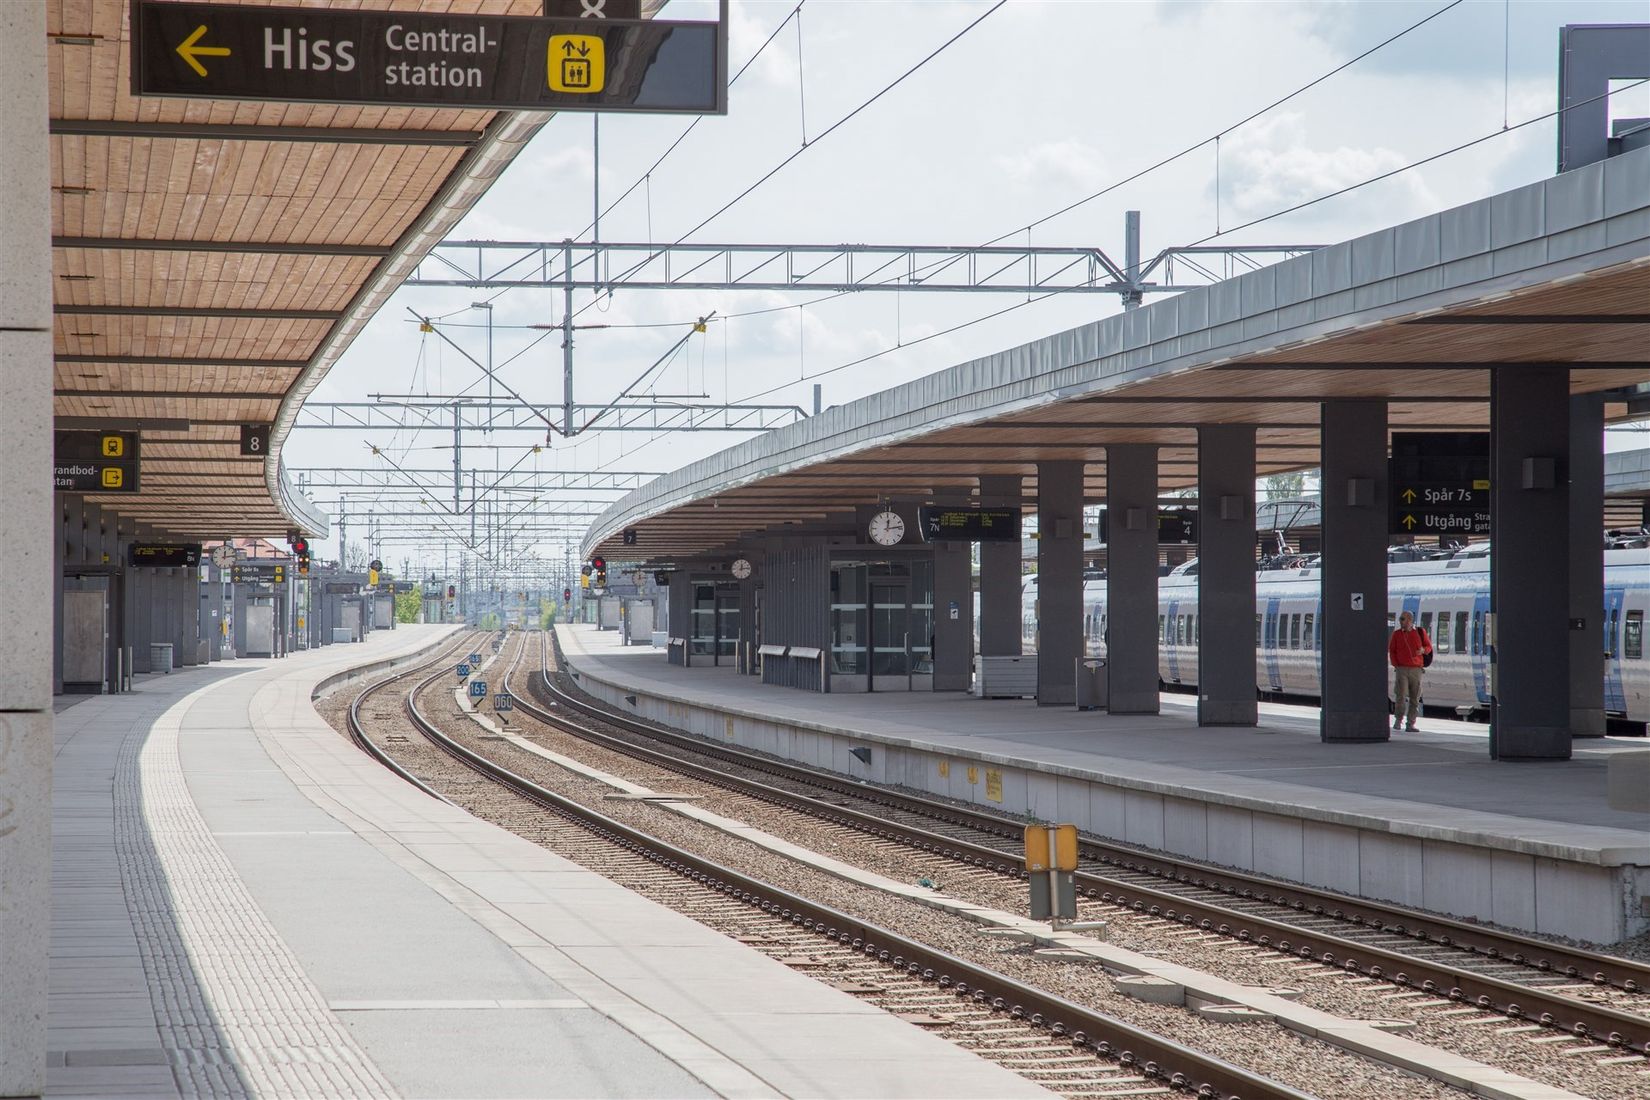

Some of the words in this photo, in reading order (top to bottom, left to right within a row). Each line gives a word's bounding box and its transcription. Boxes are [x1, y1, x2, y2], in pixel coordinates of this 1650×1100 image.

[385, 25, 497, 54] Central-
[264, 27, 356, 72] Hiss
[385, 60, 483, 88] station
[250, 436, 260, 451] 8
[53, 477, 72, 486] tan
[1424, 487, 1454, 504] Spår
[1457, 488, 1472, 501] 7s
[1425, 513, 1472, 530] Utgång
[1184, 525, 1191, 535] 4
[291, 535, 296, 543] 8
[628, 535, 632, 543] 7
[471, 683, 486, 694] 165
[495, 695, 512, 709] 060
